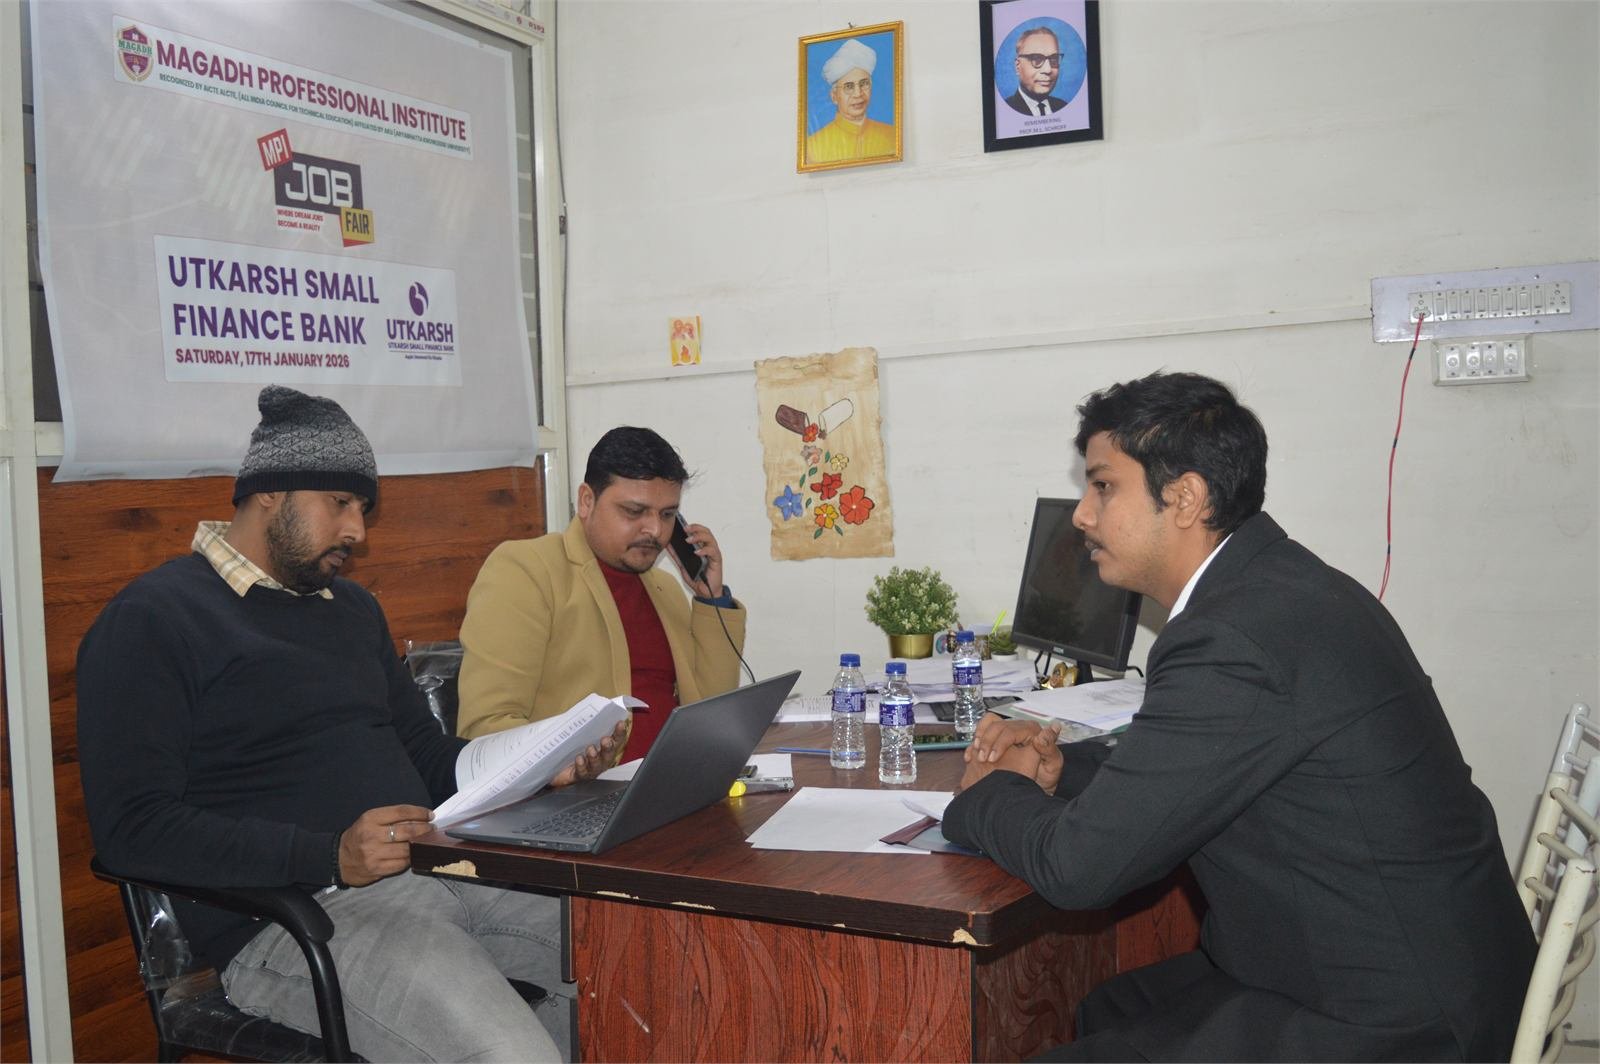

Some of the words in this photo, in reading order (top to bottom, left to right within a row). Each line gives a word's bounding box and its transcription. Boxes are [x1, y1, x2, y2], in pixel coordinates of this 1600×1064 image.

[117, 39, 153, 55] MAGADH
[156, 40, 253, 88] MAGADH
[257, 67, 389, 122] PROFESSIONAL
[392, 102, 467, 141] INSTITUTE
[159, 73, 194, 88] RECOGNIZED
[195, 82, 202, 90] BY
[250, 95, 265, 105] INDIA
[266, 99, 289, 111] COUNCIL
[289, 104, 298, 113] FOR
[299, 107, 325, 120] TECHNICAL
[261, 134, 290, 167] MPI
[285, 162, 353, 208] JOB
[277, 209, 294, 217] WHERE
[294, 211, 311, 219] DREAM
[278, 220, 298, 228] BECOME
[303, 223, 320, 231] REALITY
[345, 211, 370, 235] FAIR
[168, 255, 299, 297] UTKARSH
[304, 269, 380, 304] SMALL
[173, 303, 295, 341] FINANCE
[300, 312, 366, 345] BANK
[386, 319, 454, 343] UTKARSH
[175, 348, 244, 367] SATURDAY,
[245, 351, 271, 366] 17TH
[274, 352, 323, 368] JANUARY
[325, 354, 350, 368] 2026
[388, 342, 409, 350] UTKARSH
[409, 343, 425, 351] SMALL
